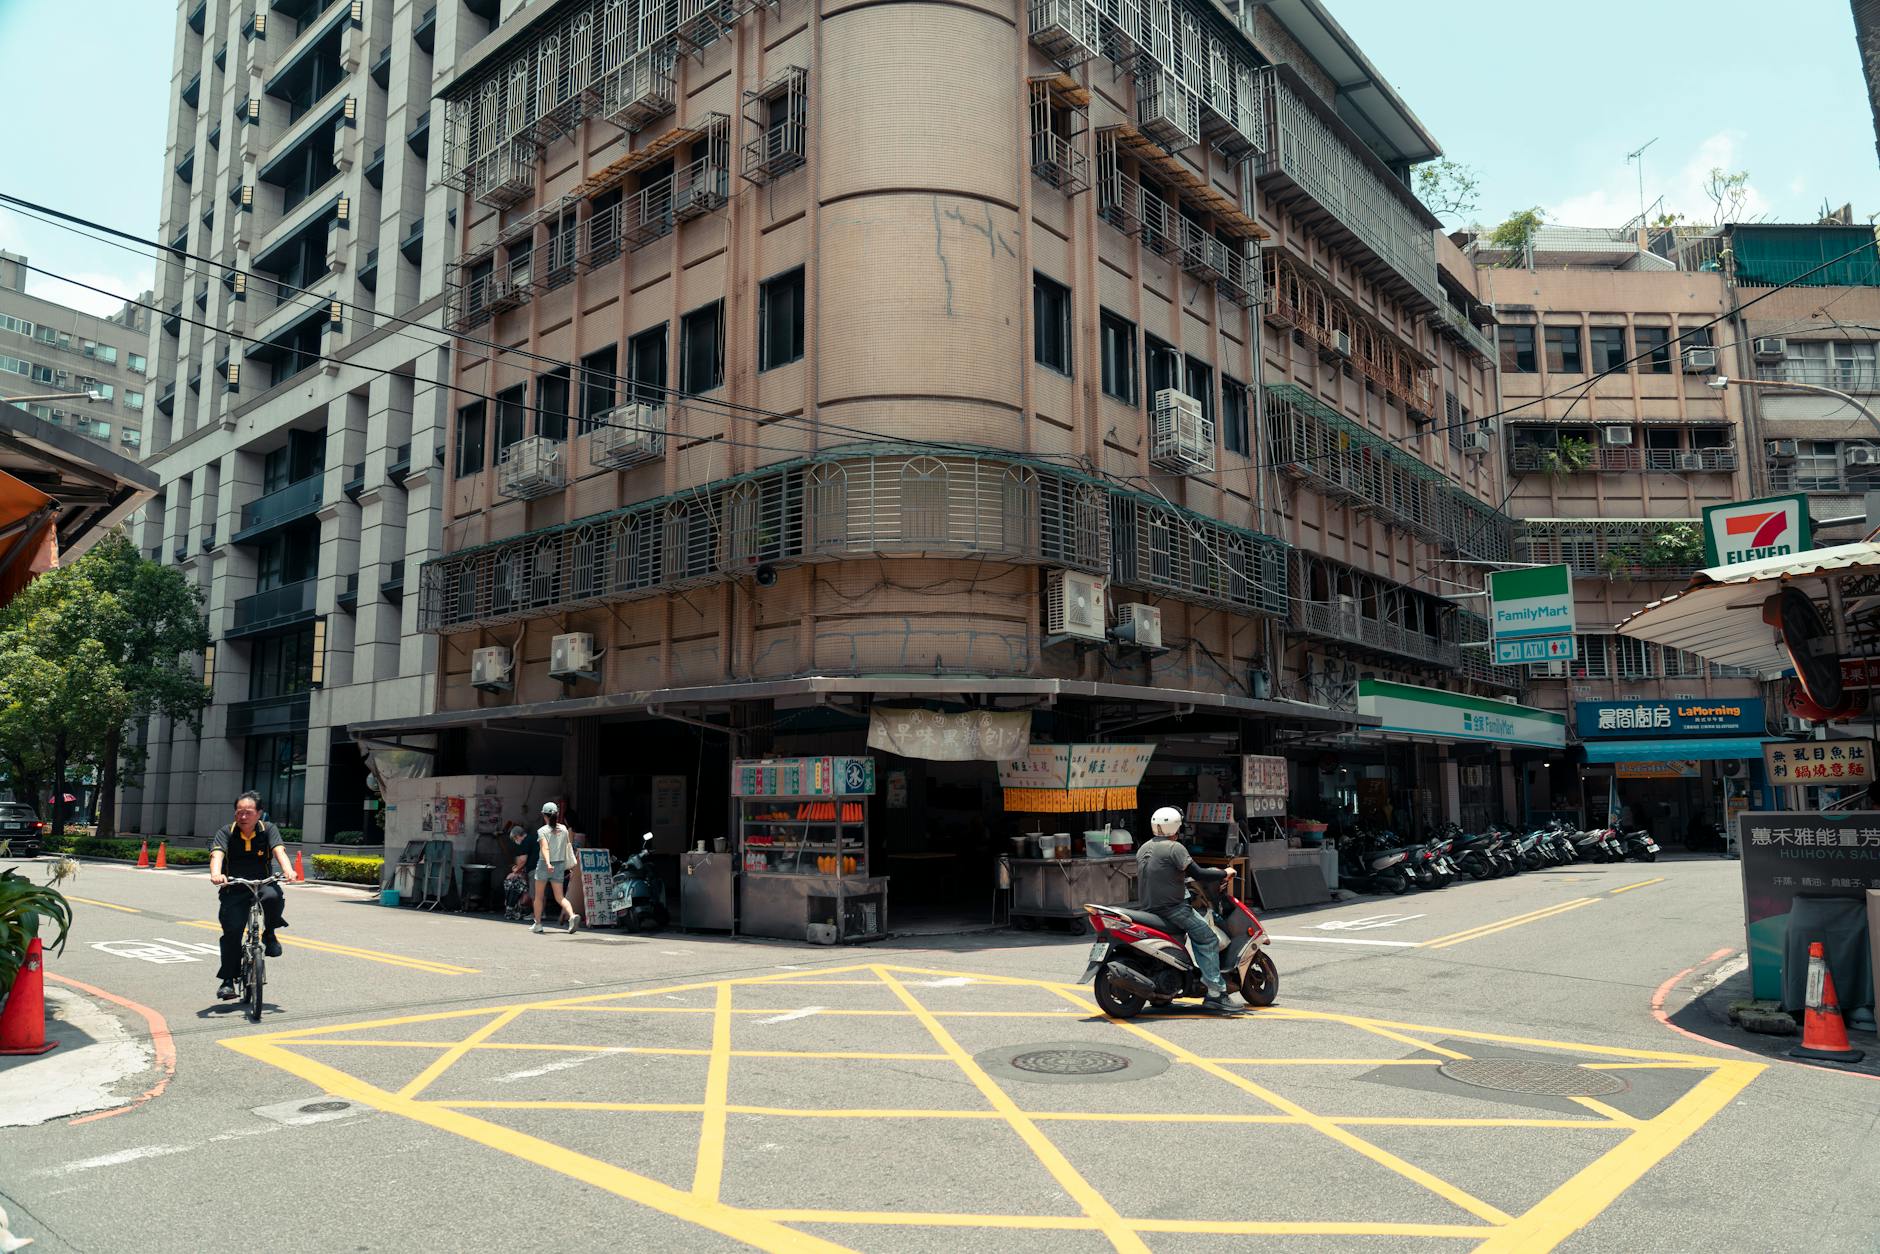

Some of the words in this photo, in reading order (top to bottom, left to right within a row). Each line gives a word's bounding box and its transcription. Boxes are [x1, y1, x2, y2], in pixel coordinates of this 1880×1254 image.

[1726, 510, 1787, 548] 7
[1497, 605, 1568, 621] FamilyMart
[1526, 642, 1545, 657] ATM
[1598, 705, 1672, 730] 晨間廚房
[1678, 704, 1741, 717] LaMorning
[1485, 716, 1515, 737] FamilyMart
[1793, 746, 1865, 761] 虱目魚肚
[1773, 751, 1788, 777] 無刺
[1794, 762, 1865, 778] 鍋燒意麵
[1780, 848, 1845, 859] HUIHOYA
[1850, 848, 1880, 860] SAL
